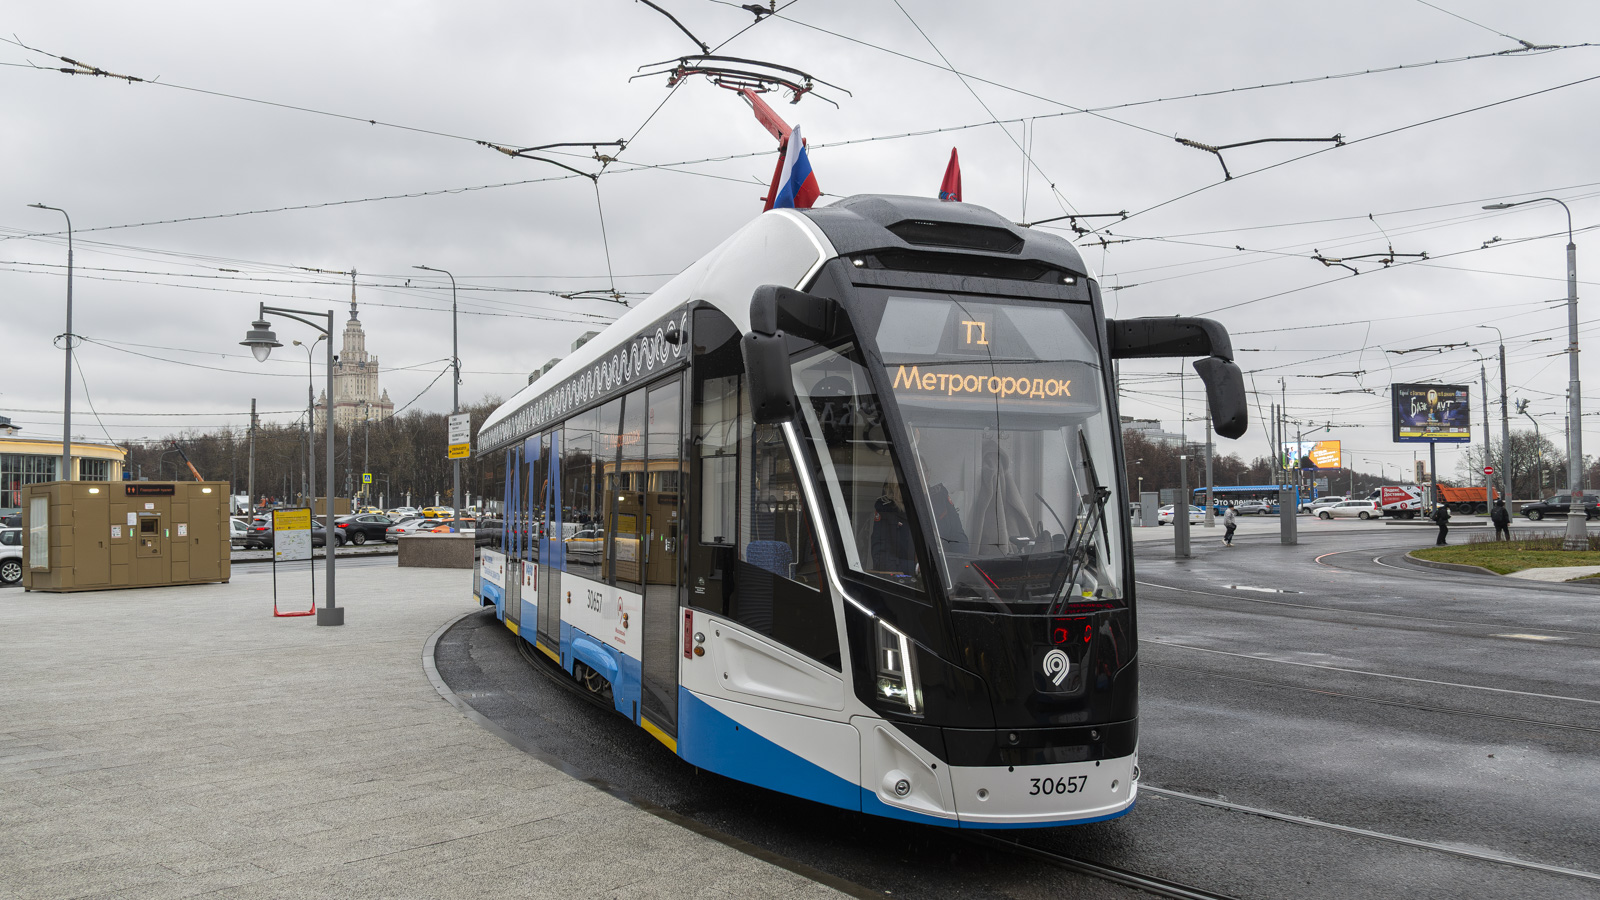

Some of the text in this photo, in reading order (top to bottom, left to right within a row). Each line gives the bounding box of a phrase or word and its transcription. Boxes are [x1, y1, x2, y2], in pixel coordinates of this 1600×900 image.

[961, 319, 989, 346] Т1
[892, 364, 1073, 399] Метрогородок
[1213, 498, 1229, 506] Это
[587, 589, 603, 613] 30657
[1029, 774, 1088, 797] 30657
